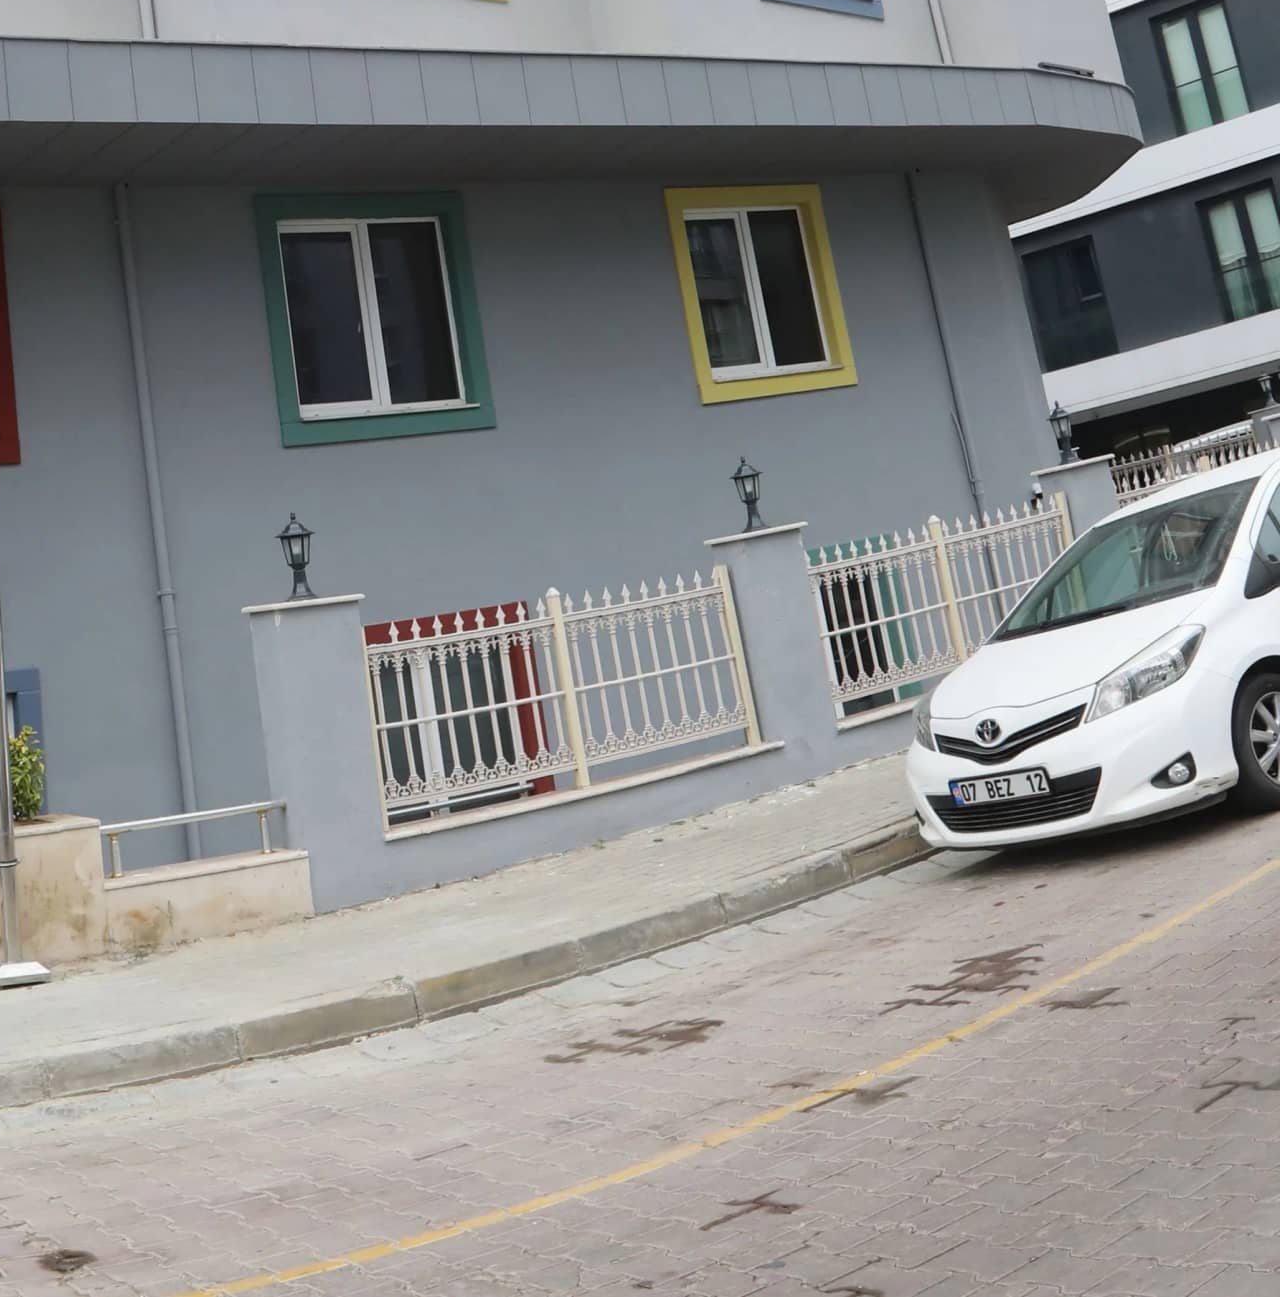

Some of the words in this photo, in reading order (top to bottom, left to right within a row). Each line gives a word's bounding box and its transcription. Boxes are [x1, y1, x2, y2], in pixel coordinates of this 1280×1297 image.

[960, 783, 976, 802] 07
[985, 777, 1015, 799] BEZ
[1026, 773, 1046, 793] 12
